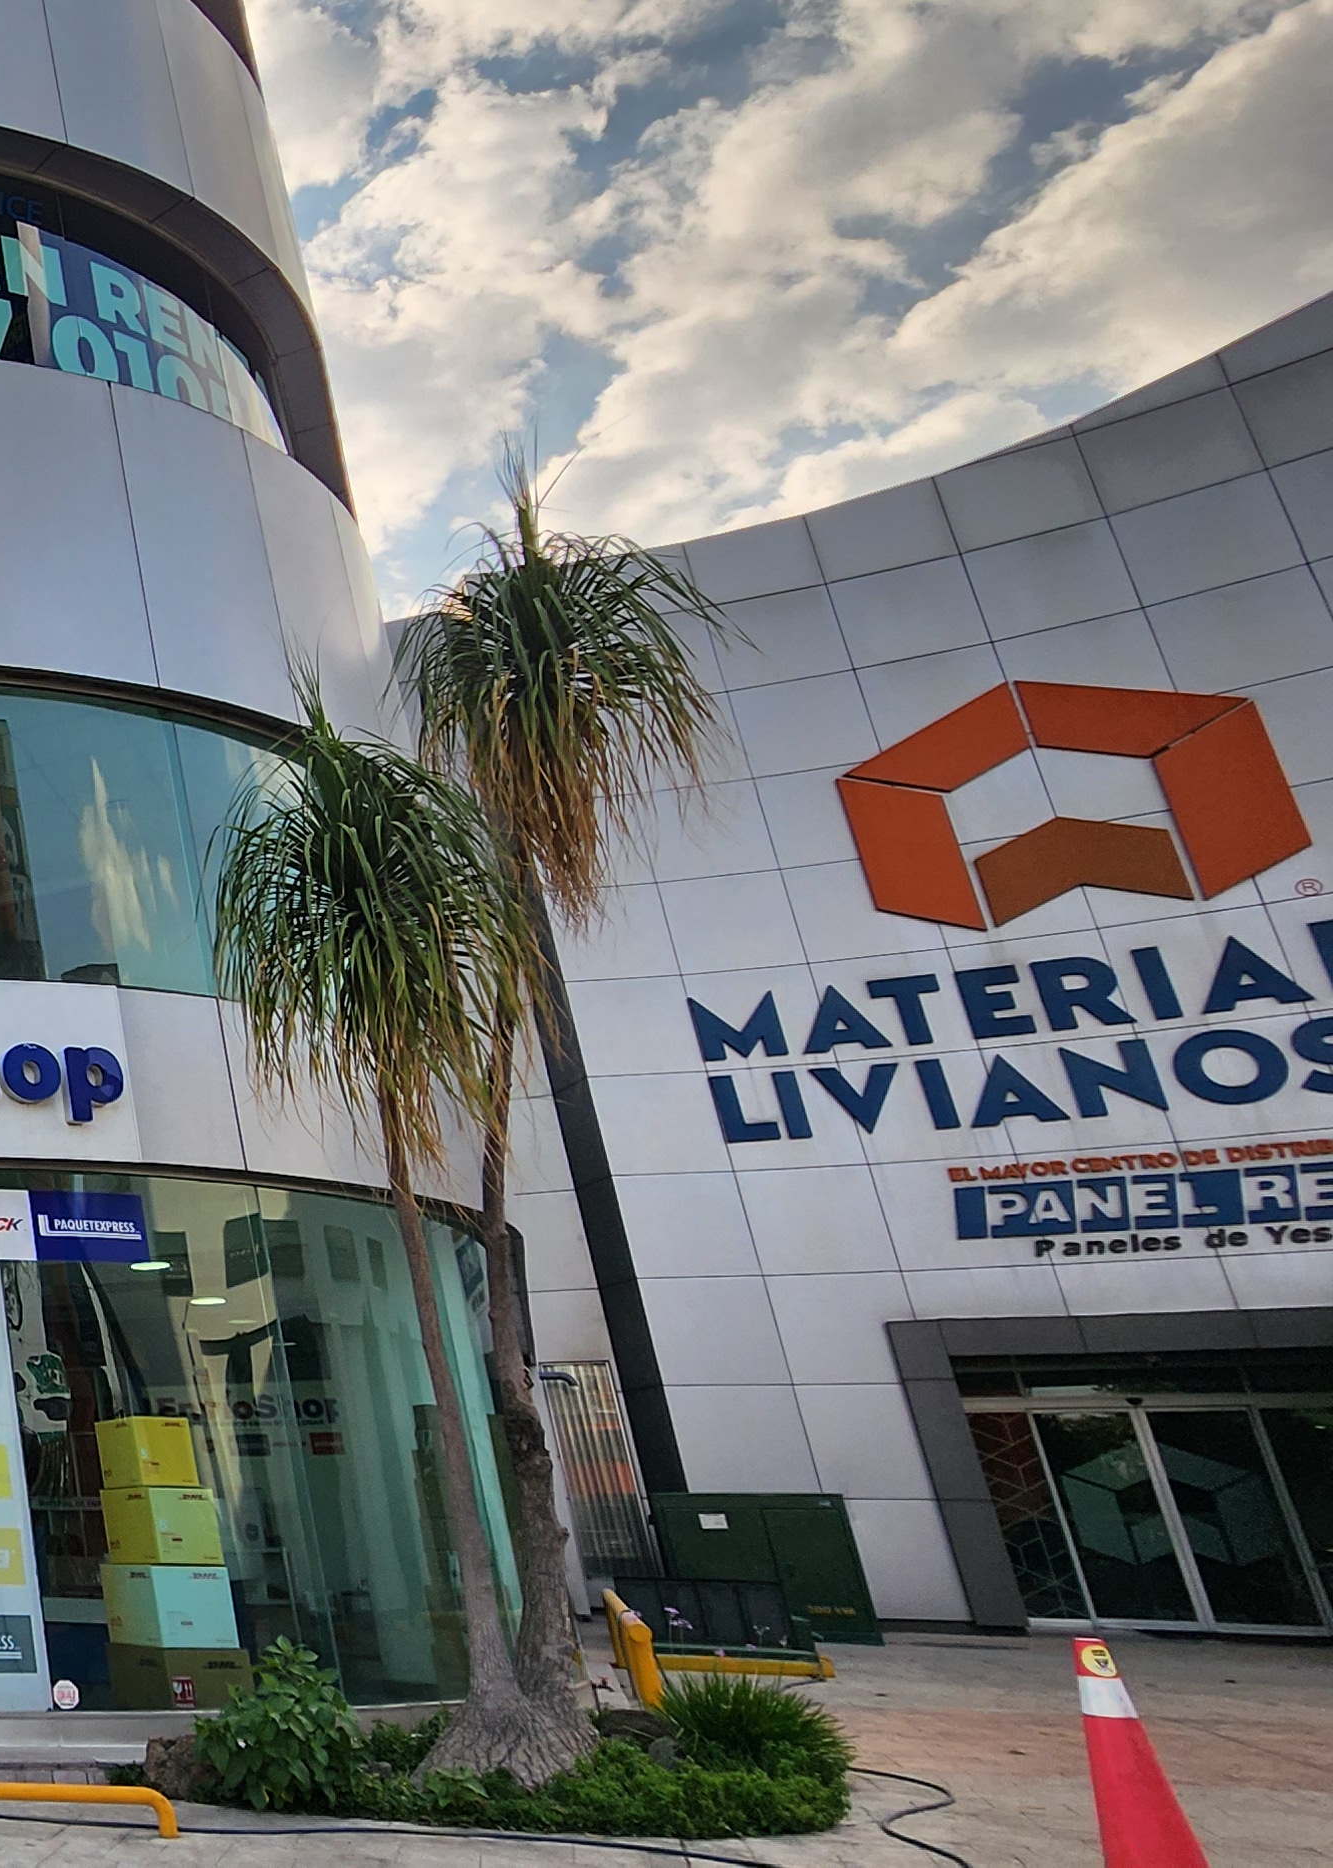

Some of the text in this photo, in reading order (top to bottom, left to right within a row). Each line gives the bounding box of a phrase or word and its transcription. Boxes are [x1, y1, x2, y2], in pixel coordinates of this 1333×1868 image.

[947, 1166, 978, 1182] EL
[983, 1160, 1069, 1180] MAYOR
[1072, 1152, 1180, 1174] CENTRO
[1184, 1148, 1220, 1166] DE
[986, 1176, 1220, 1229] PANEL
[53, 1218, 136, 1234] PAQUETEXPRESS
[1035, 1225, 1333, 1258] Paneles de Yes
